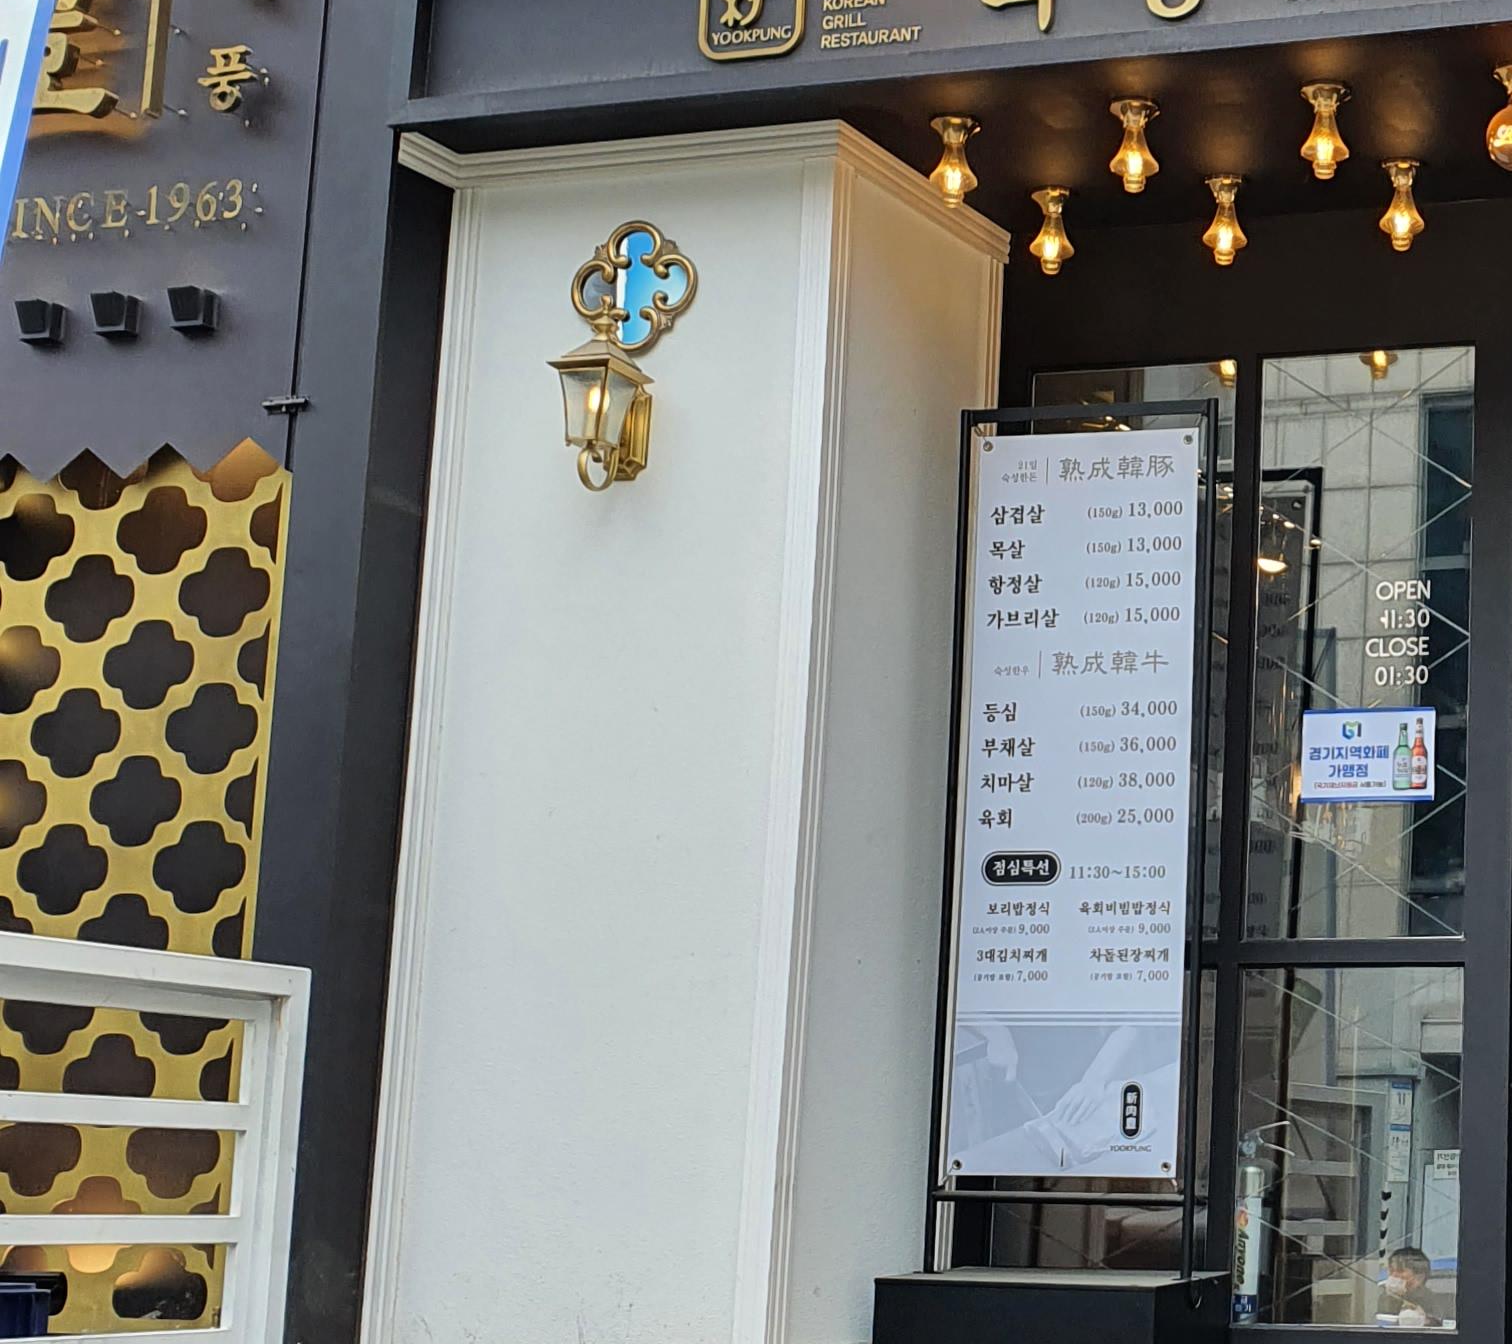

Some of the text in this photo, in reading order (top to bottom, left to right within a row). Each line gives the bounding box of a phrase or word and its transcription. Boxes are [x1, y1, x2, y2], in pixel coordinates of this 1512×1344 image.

[822, 12, 867, 30] GRILL
[711, 24, 793, 47] YOOKPUNG
[820, 25, 923, 50] RESTAURANT
[11, 177, 244, 240] INCE 1963
[1058, 455, 1175, 482] 熟成韓豚
[990, 501, 1183, 526] 삼겹살 (150g) 13,000
[989, 536, 1182, 560] 목살 (150g) 13,000
[988, 571, 1181, 595] 항정살 (120g) 15,000
[1375, 580, 1431, 601] OPEN
[986, 606, 1180, 630] 가브리살 (120g) 15,000
[1365, 637, 1430, 657] CLOSE
[1052, 650, 1169, 675] 熟成韓牛
[1374, 665, 1429, 686] 01:30
[982, 701, 1178, 723] 등심 (150g) 34,000
[981, 737, 1177, 758] 부채살 (150g) 36,000
[1309, 745, 1390, 761] 경기지역화폐
[1327, 764, 1369, 779] 가맹점
[980, 772, 1175, 793] 치마살 (120g) 38,000
[978, 808, 1174, 829] 육회 (200g) 25,000
[992, 859, 1166, 880] 점심특선 11:30~15:00
[986, 901, 1051, 916] 보리밥정식
[1079, 900, 1171, 916] 육회비빔밥정식
[1018, 923, 1050, 936] 9,000
[1138, 922, 1171, 936] 9,000
[976, 948, 1048, 964] 3대김치찌개
[1089, 947, 1170, 964] 차돌된장찌개
[1016, 969, 1049, 984] 7,000
[1136, 969, 1170, 984] 7,000
